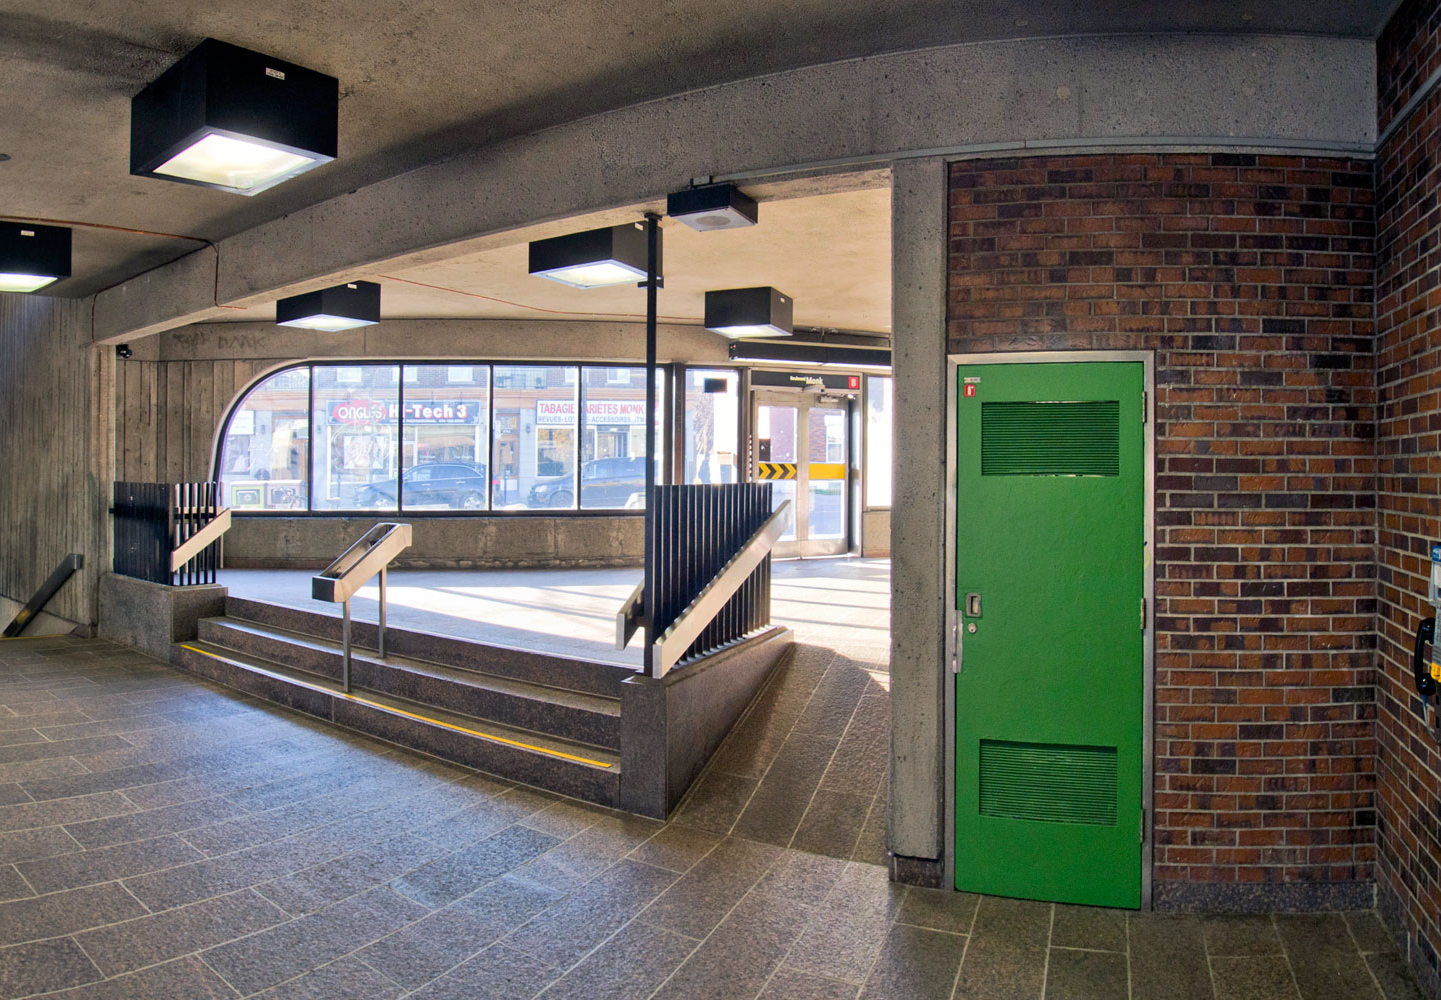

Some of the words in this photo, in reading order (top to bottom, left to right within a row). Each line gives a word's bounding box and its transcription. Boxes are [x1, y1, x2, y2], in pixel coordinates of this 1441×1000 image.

[806, 376, 824, 385] Monk
[456, 403, 468, 419] 3
[539, 403, 575, 415] TABAGIE
[584, 401, 619, 415] ARIÉTES
[620, 403, 645, 415] MONK
